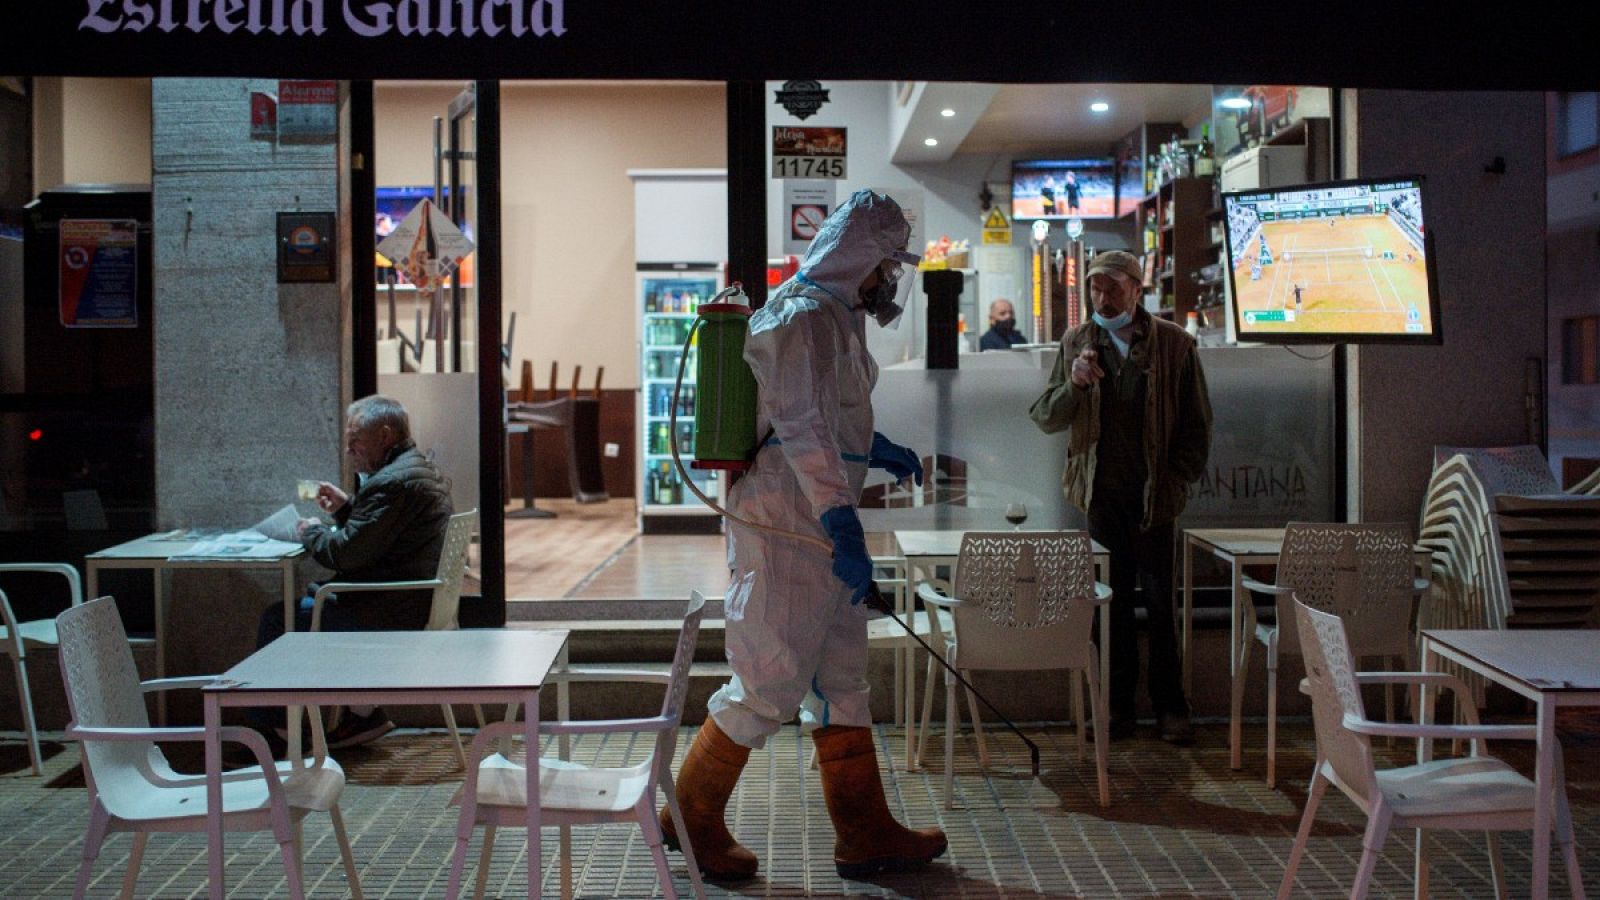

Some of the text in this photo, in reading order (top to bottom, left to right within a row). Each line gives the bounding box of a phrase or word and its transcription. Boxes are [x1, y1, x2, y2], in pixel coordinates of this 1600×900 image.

[78, 0, 568, 37] Estrella Galicia
[777, 158, 843, 177] 11745
